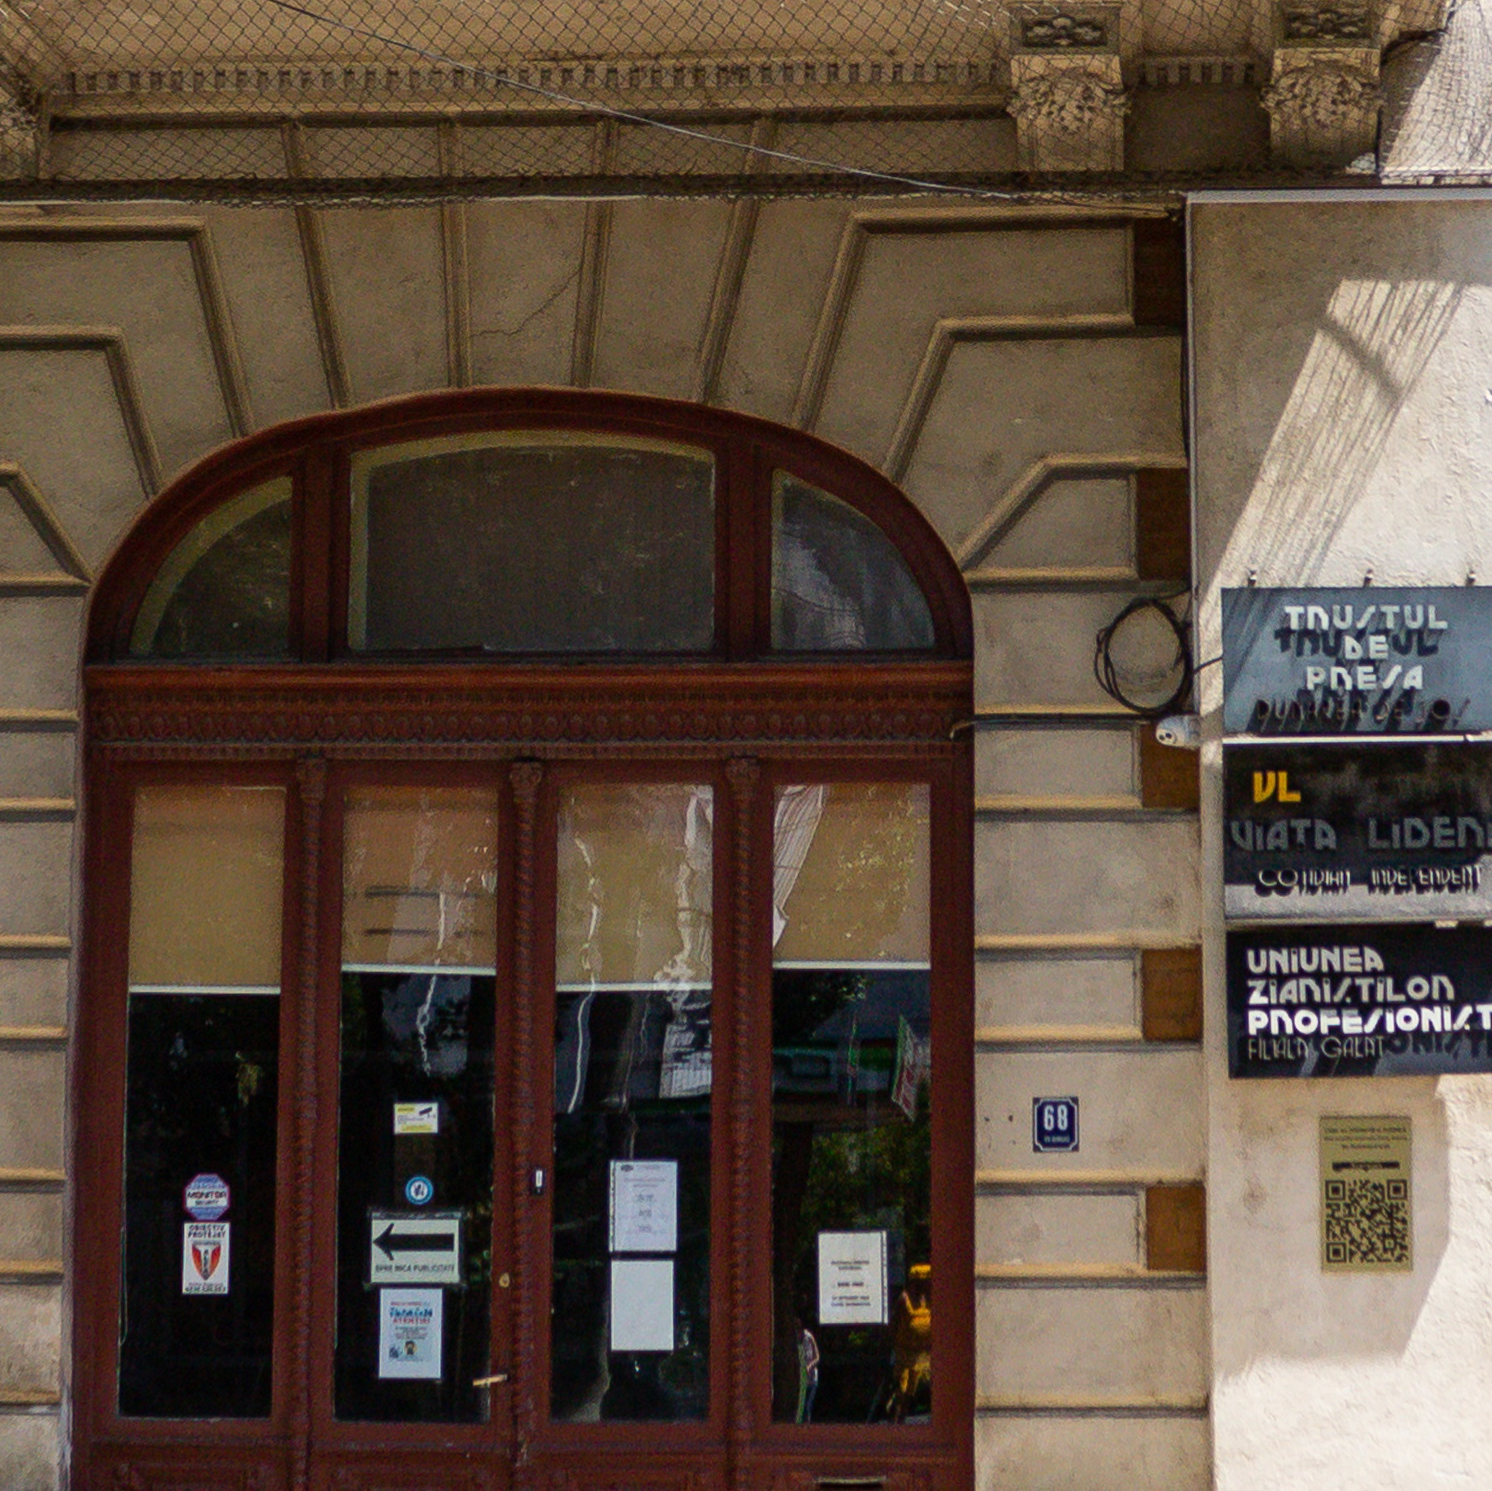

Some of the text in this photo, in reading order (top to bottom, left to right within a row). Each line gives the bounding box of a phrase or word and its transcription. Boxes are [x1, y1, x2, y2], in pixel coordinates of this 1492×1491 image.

[1284, 605, 1449, 631] TRUSTUL
[1344, 635, 1389, 660] DE
[1306, 664, 1424, 691] PRESA
[1252, 771, 1302, 804] VL
[1246, 946, 1385, 974] UNIUNEA
[1043, 1104, 1069, 1131] 68
